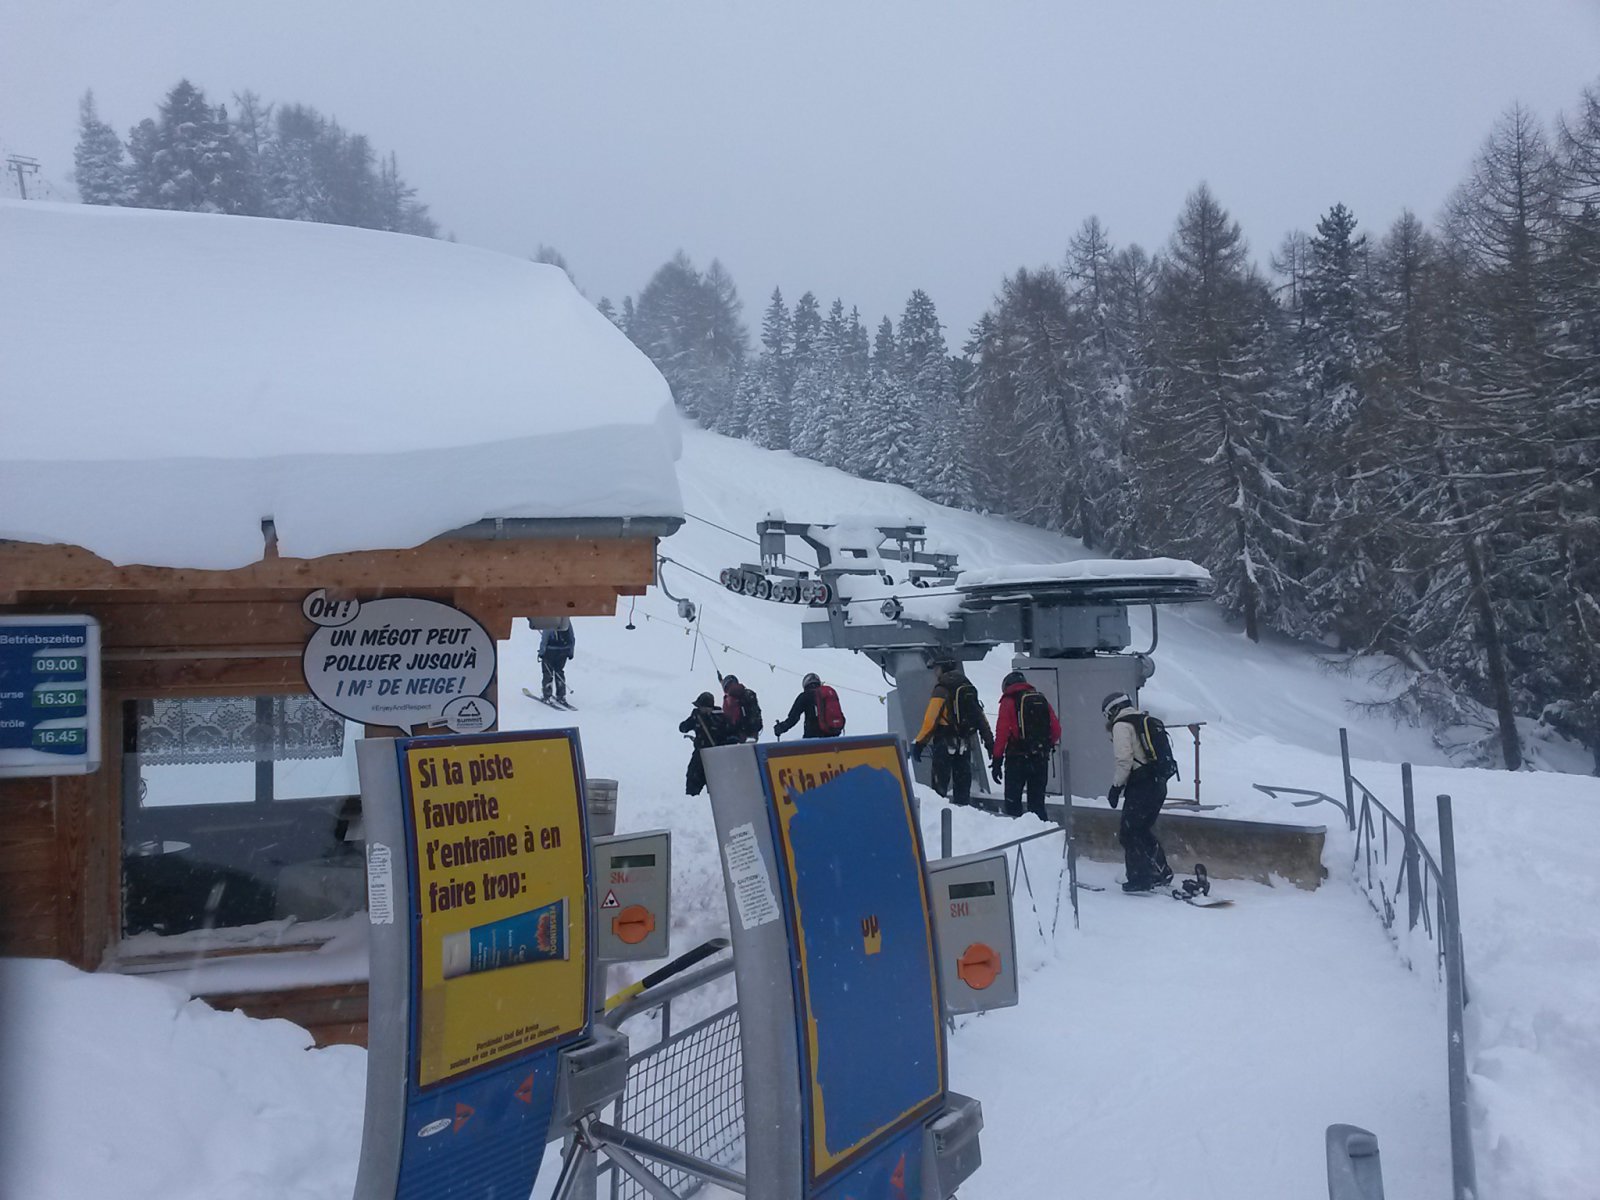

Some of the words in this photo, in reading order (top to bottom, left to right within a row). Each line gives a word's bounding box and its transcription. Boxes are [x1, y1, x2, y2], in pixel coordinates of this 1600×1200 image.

[0, 634, 84, 645] Betriebszeiten
[330, 630, 357, 647] UN
[360, 624, 422, 647] MÉGOT
[425, 628, 472, 645] PEUT
[36, 659, 77, 671] 09.00
[323, 654, 402, 673] POLLUER
[406, 646, 477, 671] JUSQU'À
[377, 679, 402, 696] DE
[38, 692, 77, 705] 16.30
[38, 730, 77, 743] 16.45
[418, 757, 438, 789] Si
[442, 758, 464, 786] ta
[469, 753, 514, 786] piste
[423, 793, 499, 829] favorite
[426, 831, 518, 871] t'entraîne
[524, 825, 535, 853] à
[540, 826, 561, 850] en
[429, 878, 476, 913] faire
[483, 871, 527, 901] trop:
[950, 901, 969, 918] SKI
